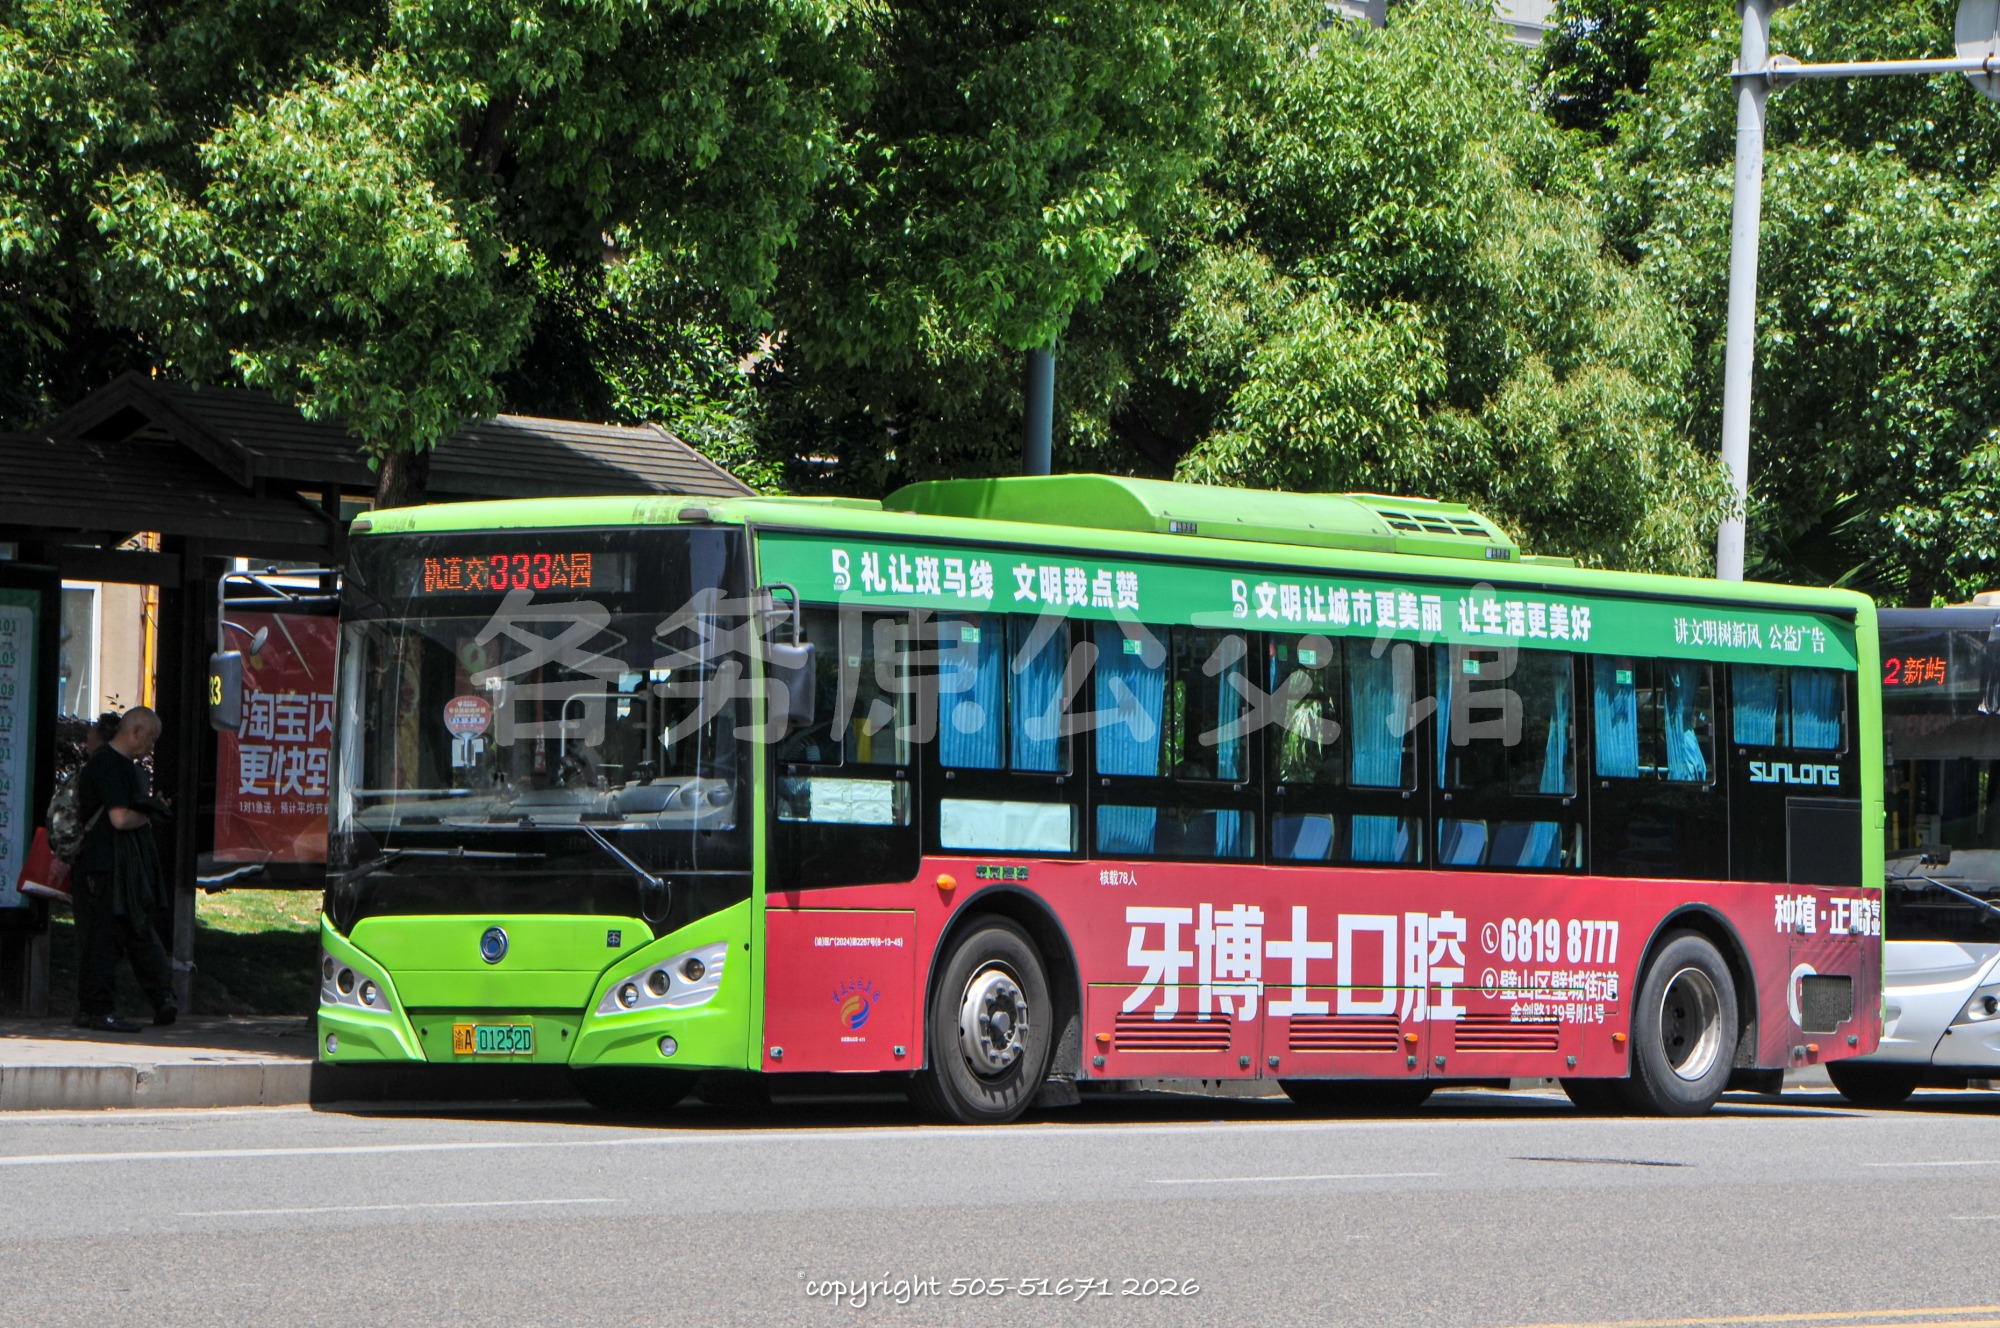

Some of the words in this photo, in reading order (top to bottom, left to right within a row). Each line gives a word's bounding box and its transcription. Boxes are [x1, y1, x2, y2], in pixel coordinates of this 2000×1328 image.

[424, 556, 489, 592] 轨道交
[490, 553, 551, 590] 333
[861, 551, 994, 600] 礼让斑马线
[1013, 562, 1139, 610] 文明我点赞
[1255, 581, 1441, 632] 文明让城市更美丽
[1459, 597, 1591, 642] 让生活更美好
[1674, 617, 1762, 649] 讲文明树新风
[1768, 625, 1825, 654] 公益广告
[1749, 761, 1840, 786] SUNLONG
[1100, 869, 1137, 886] 核载78人
[1501, 917, 1561, 963] 6819
[1567, 919, 1619, 964] 8777
[1122, 902, 1467, 1023] 牙博士口腔
